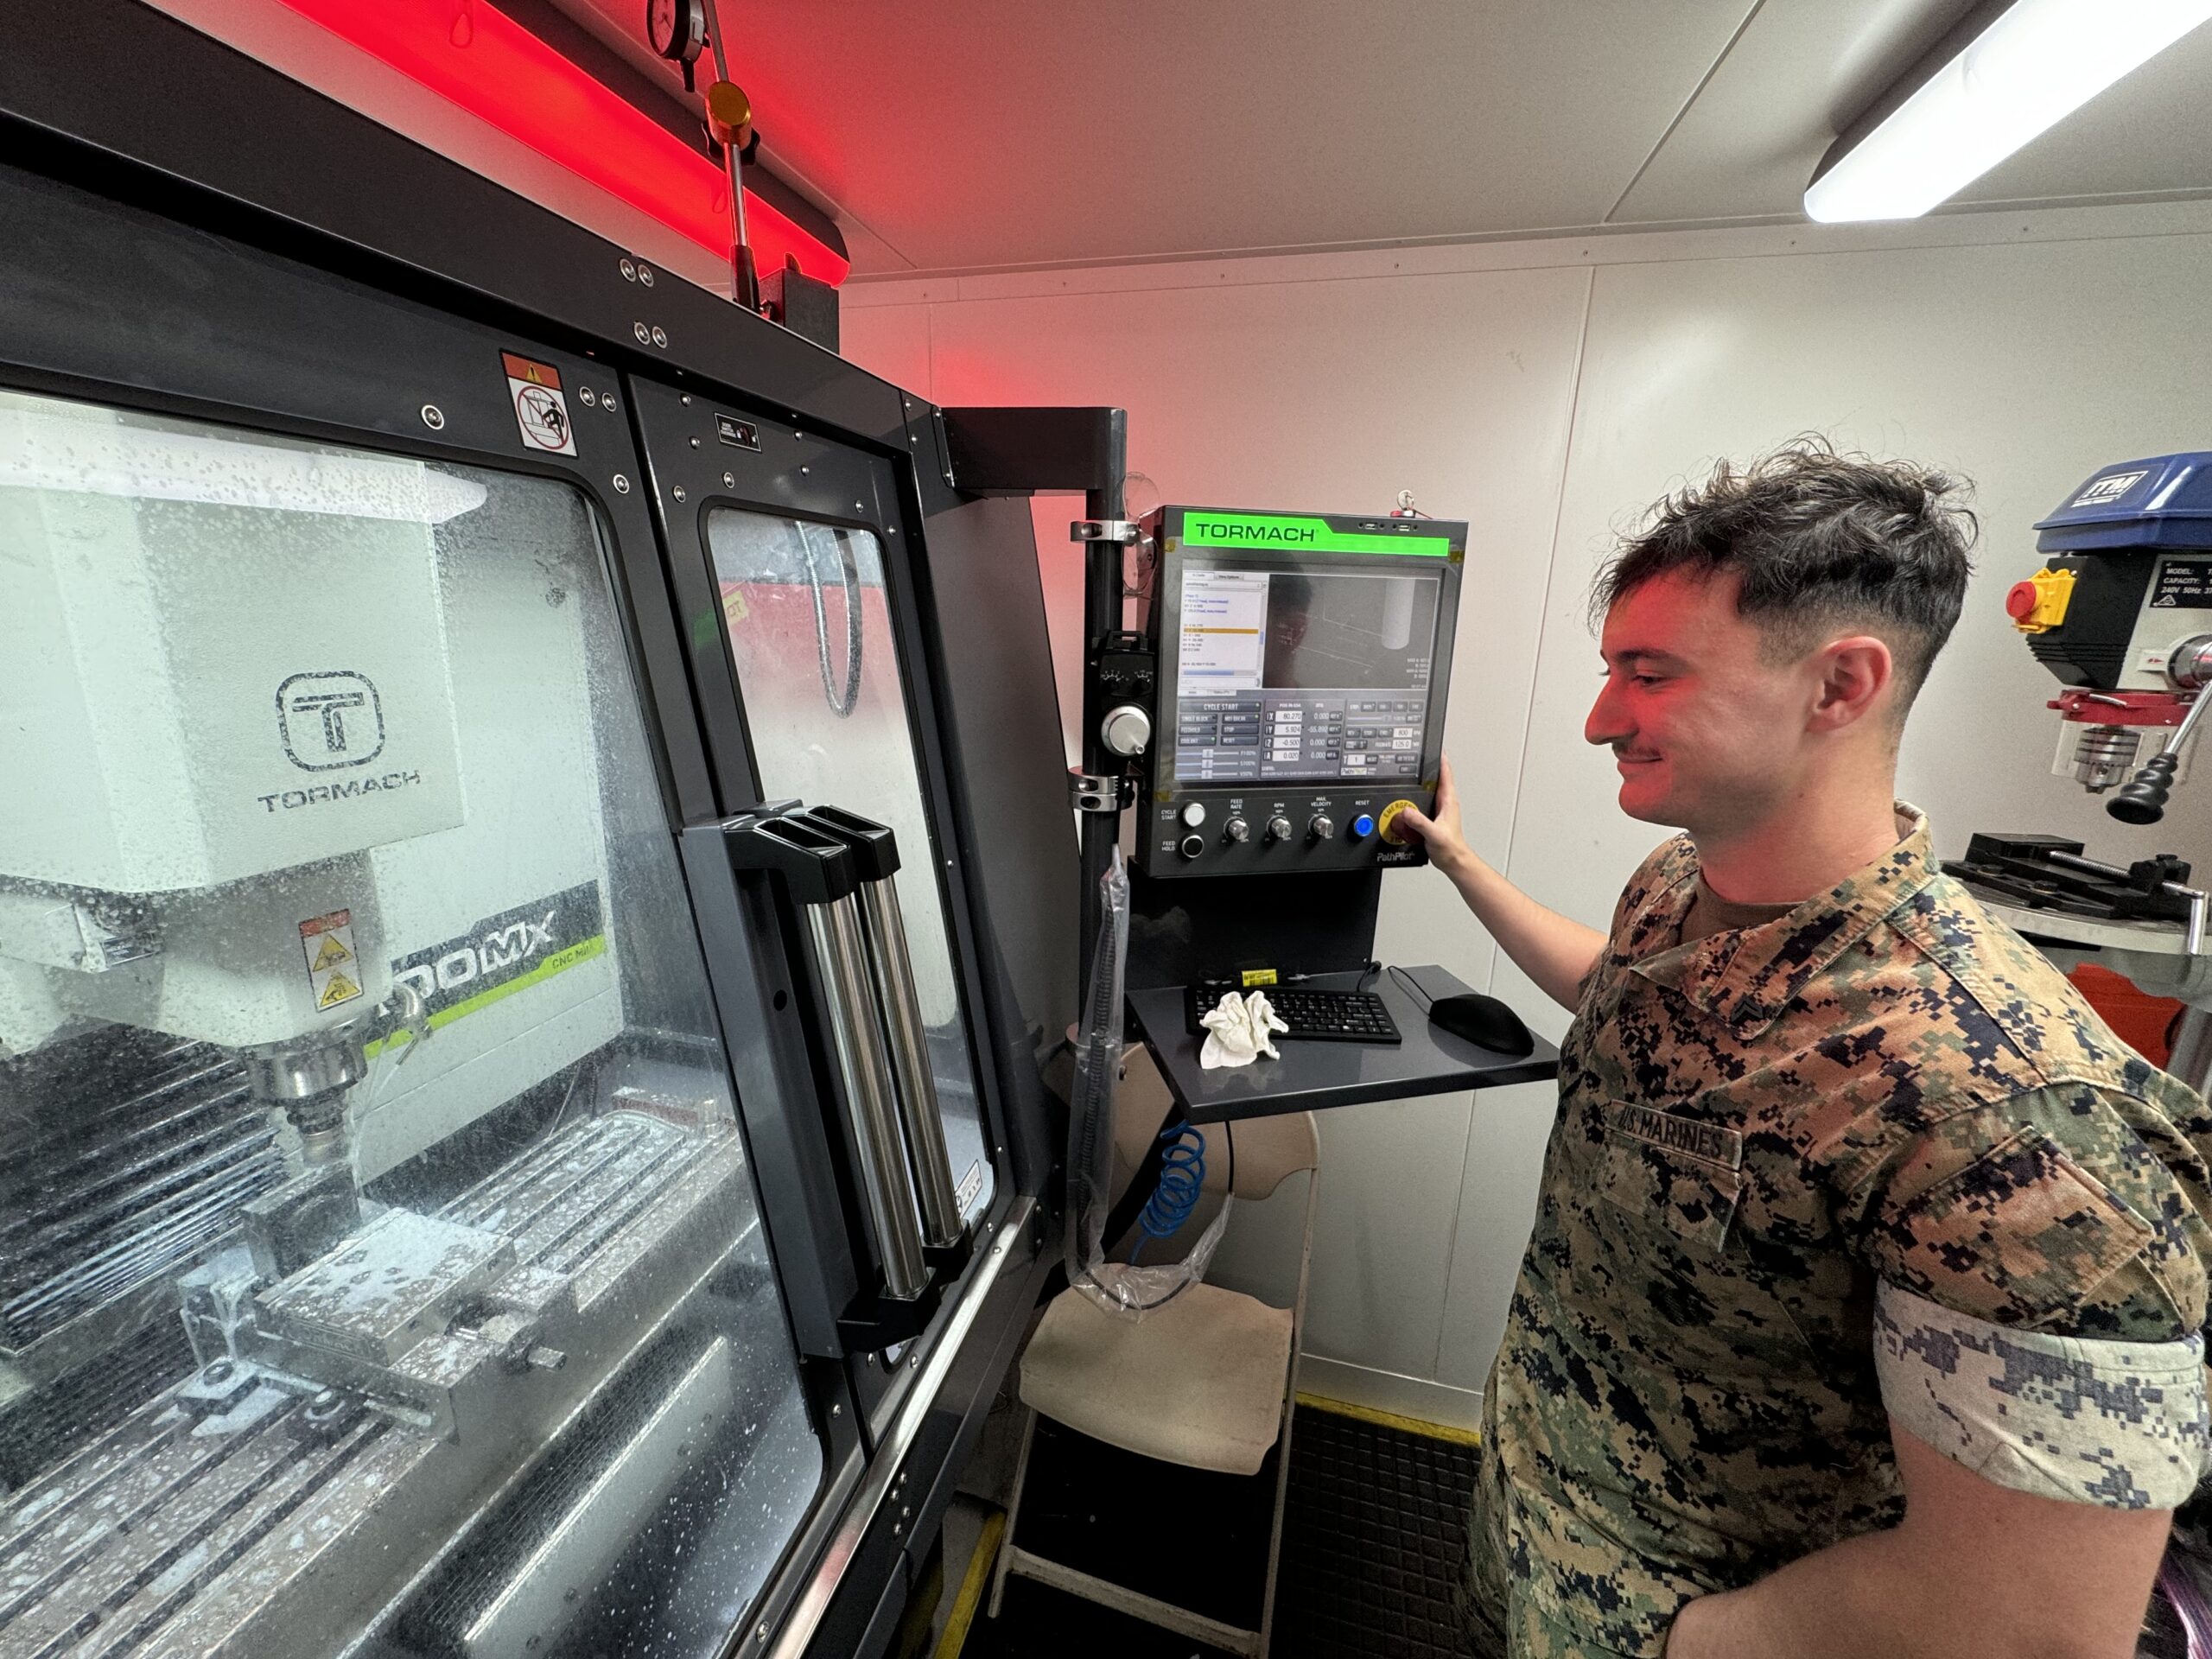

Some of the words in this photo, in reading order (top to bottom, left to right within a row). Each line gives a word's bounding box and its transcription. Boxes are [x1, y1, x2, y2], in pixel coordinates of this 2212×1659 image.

[1196, 523, 1315, 543] TORMACH
[257, 770, 421, 812] TORMACH
[1377, 851, 1413, 862] PathPilot
[553, 952, 573, 969] CNC
[1638, 1111, 1723, 1160] MARINES
